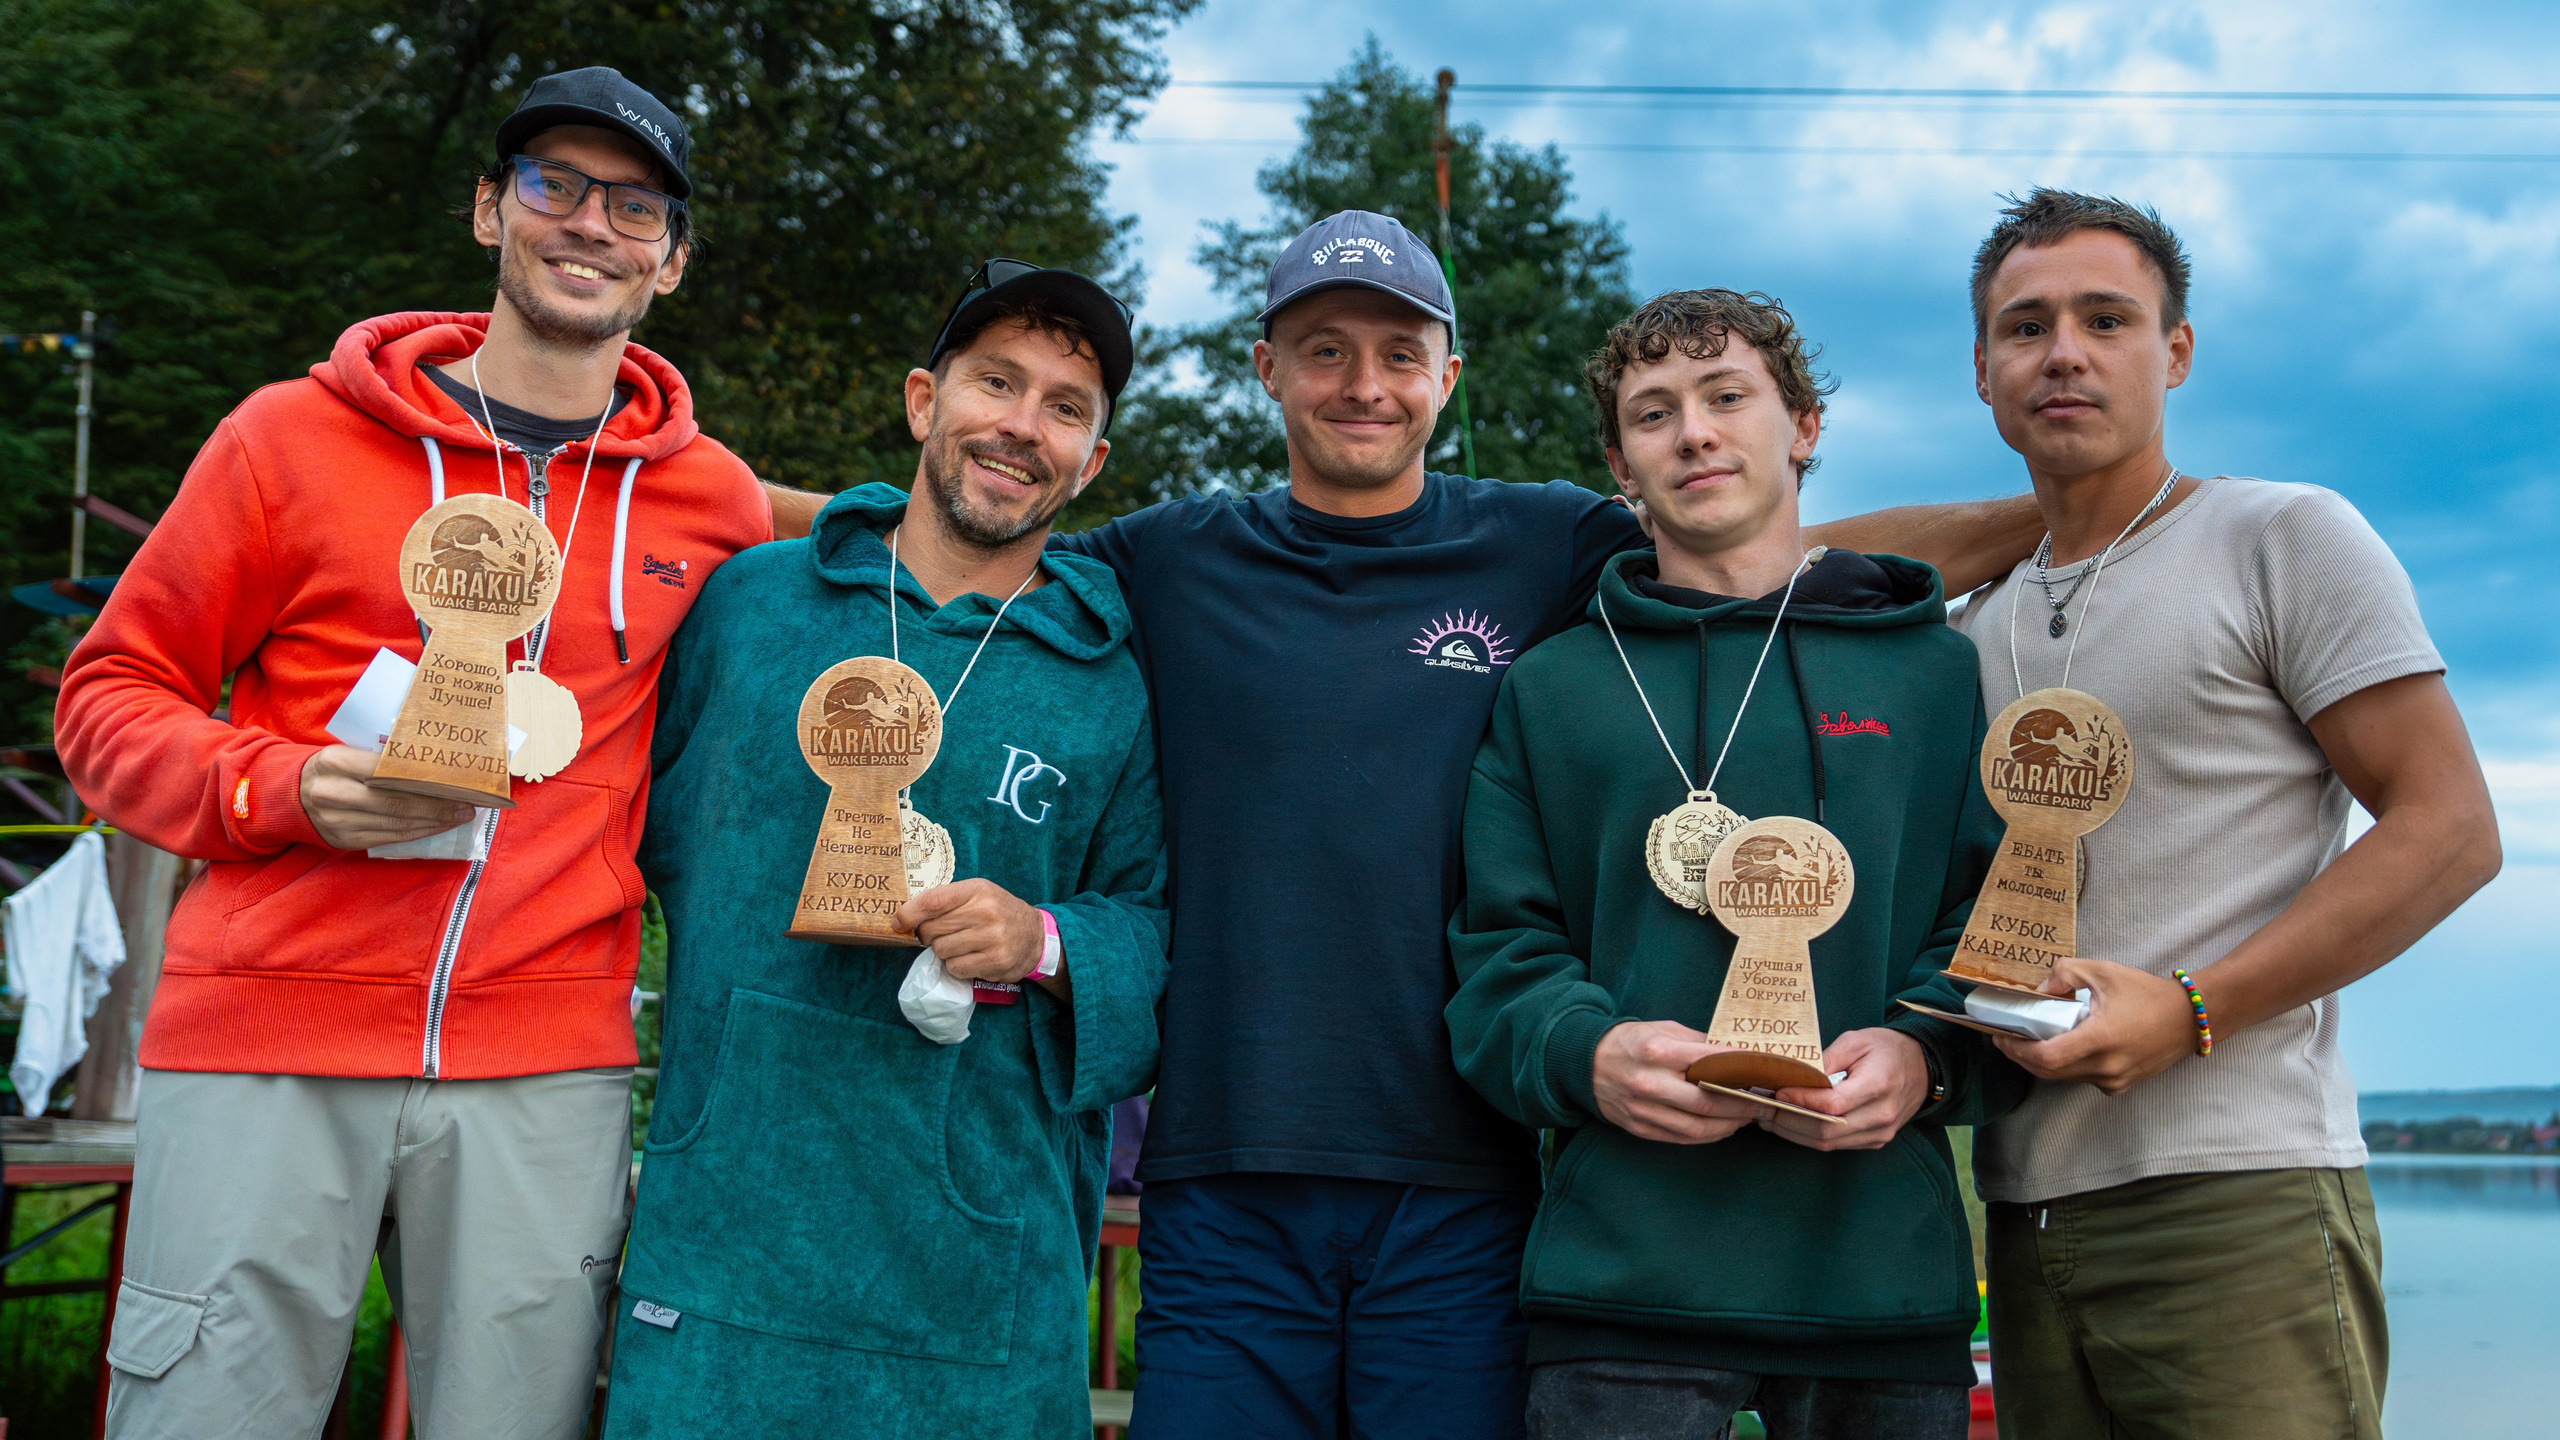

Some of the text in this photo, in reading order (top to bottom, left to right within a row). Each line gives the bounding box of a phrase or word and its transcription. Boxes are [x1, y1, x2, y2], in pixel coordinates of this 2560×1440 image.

[616, 102, 672, 154] WAKE
[1311, 237, 1396, 266] BILLABONG
[414, 566, 537, 605] KARAKUL
[431, 595, 521, 616] WAKE PARK
[431, 653, 501, 681] Хорошо,
[422, 669, 505, 696] Но можно
[429, 688, 492, 710] Лучше!
[417, 719, 489, 746] КУБОК
[812, 728, 922, 756] KARAKUL
[387, 741, 508, 776] КАРАКУЛЬ
[828, 754, 909, 766] WAKE PARK
[1993, 758, 2110, 800] KARAKUL
[2007, 790, 2092, 810] WAKE PARK
[851, 826, 872, 839] Не
[820, 838, 902, 857] Четвертый!
[1669, 840, 1721, 861] KARAK
[2010, 841, 2066, 865] ЕБАТЬ
[826, 871, 891, 891] КУБОК
[2024, 865, 2044, 879] ты
[1719, 881, 1833, 907] KARAKUL
[1996, 878, 2067, 903] молодец!
[802, 894, 908, 915] КАРАКУЛ
[1736, 906, 1819, 917] WAKE PARK
[1990, 914, 2058, 943] КУБОК
[1962, 934, 2073, 969] КАРАКУЛ
[1739, 957, 1803, 973] Лучшая
[1743, 971, 1798, 987] Уборка
[1731, 987, 1806, 1004] в Округе!
[1732, 1017, 1800, 1036] КУБОК
